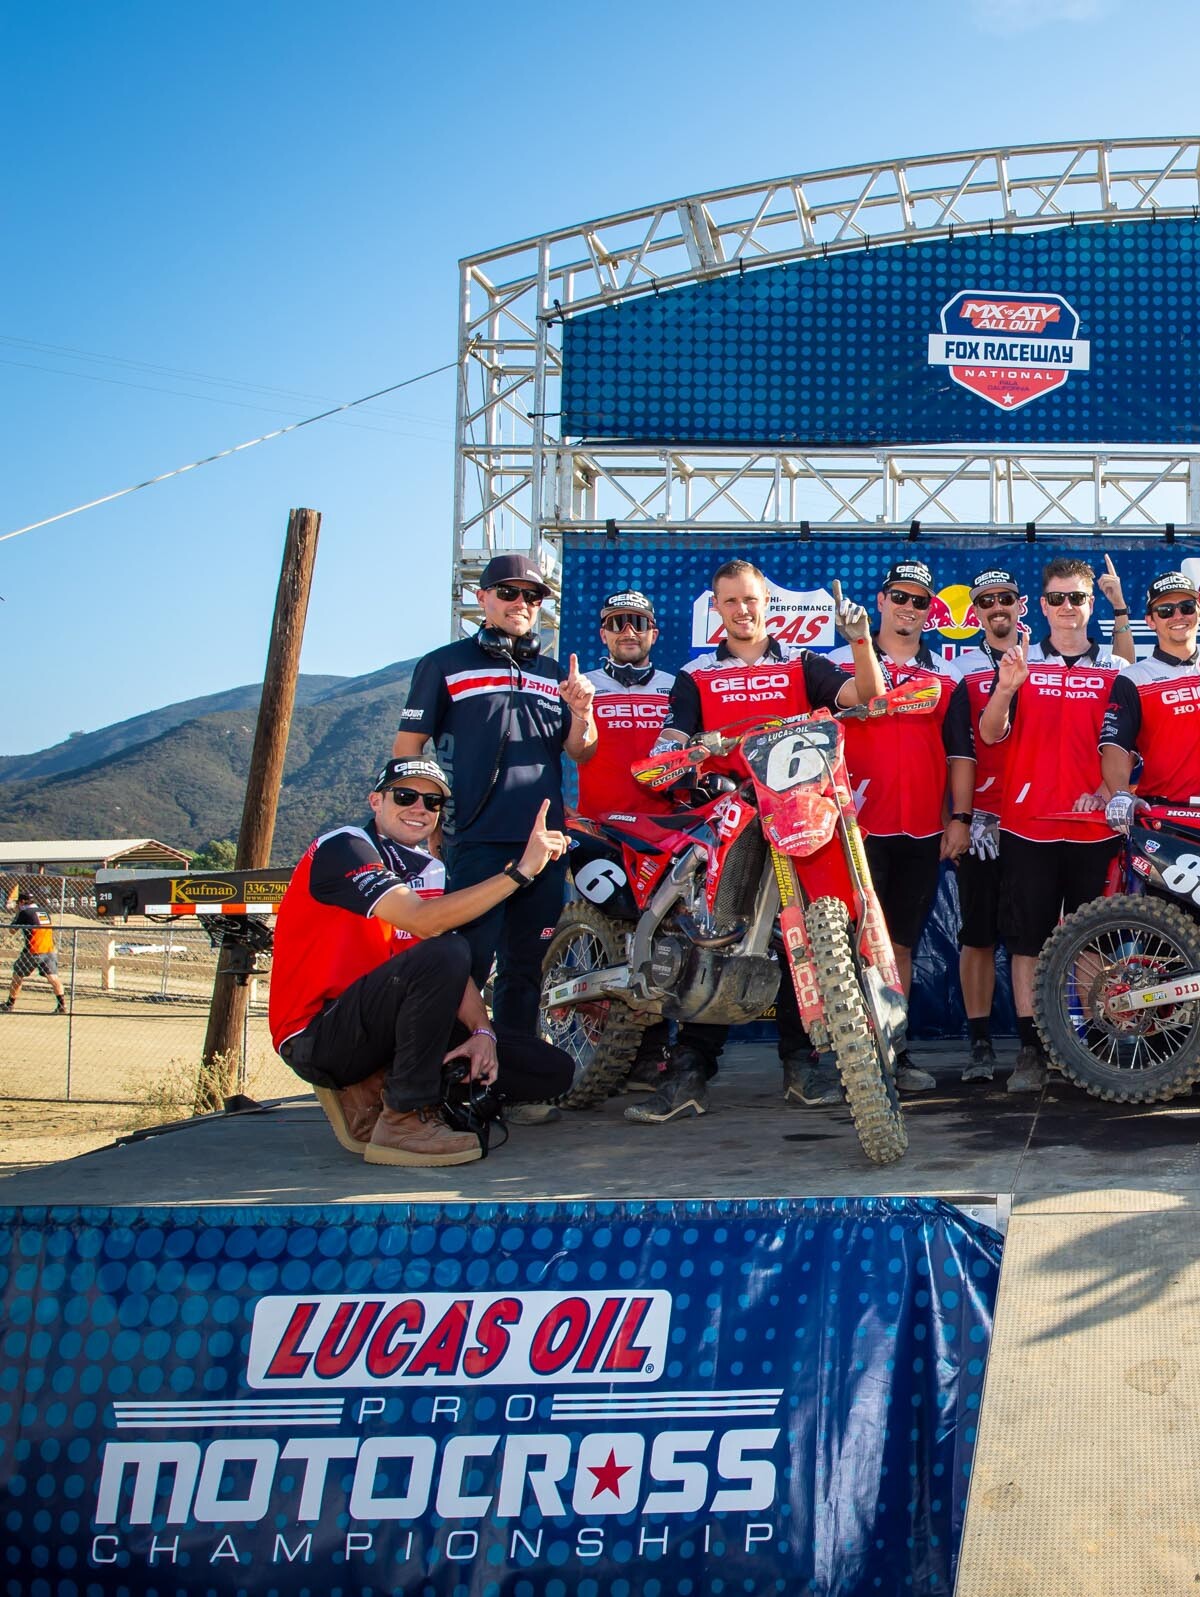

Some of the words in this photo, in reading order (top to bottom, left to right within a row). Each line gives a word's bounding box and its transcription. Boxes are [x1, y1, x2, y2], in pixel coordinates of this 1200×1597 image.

[973, 319, 1008, 330] ALL
[1009, 320, 1041, 332] OUT
[945, 340, 981, 360] FOX
[983, 342, 1073, 364] RACEWAY
[964, 369, 1054, 380] NATIONAL
[896, 565, 932, 583] GEICO
[899, 572, 930, 587] HONDA
[974, 571, 1010, 586] GEICO
[1153, 575, 1192, 590] GEICO
[1159, 583, 1191, 593] HONDA
[609, 592, 649, 607] GEICO
[769, 604, 833, 612] PERFORMANCE
[710, 673, 790, 693] GEICO
[1029, 672, 1104, 689] GEICO
[721, 691, 787, 704] HONDA
[1038, 687, 1099, 699] HONDA
[597, 704, 672, 719] GEICO
[898, 701, 936, 713] CYCRA
[793, 726, 809, 735] OIL
[766, 731, 831, 793] 6
[394, 760, 446, 782] GEICO
[652, 767, 685, 787] CYCRA
[778, 829, 826, 847] GEICO
[574, 858, 627, 904] 6
[770, 844, 789, 906] onnection
[169, 879, 234, 904] Kaufman
[247, 883, 288, 895] 336-790
[863, 908, 897, 987] GEICO
[786, 926, 819, 1008] GICO
[572, 981, 588, 993] DID
[1174, 983, 1200, 996] DID
[264, 1296, 523, 1381] LUCAS
[527, 1296, 656, 1377] OIL
[357, 1393, 537, 1426] PRO
[95, 1427, 781, 1525] MOTOCROSS
[90, 1523, 774, 1564] CHAMPIONSHIP
